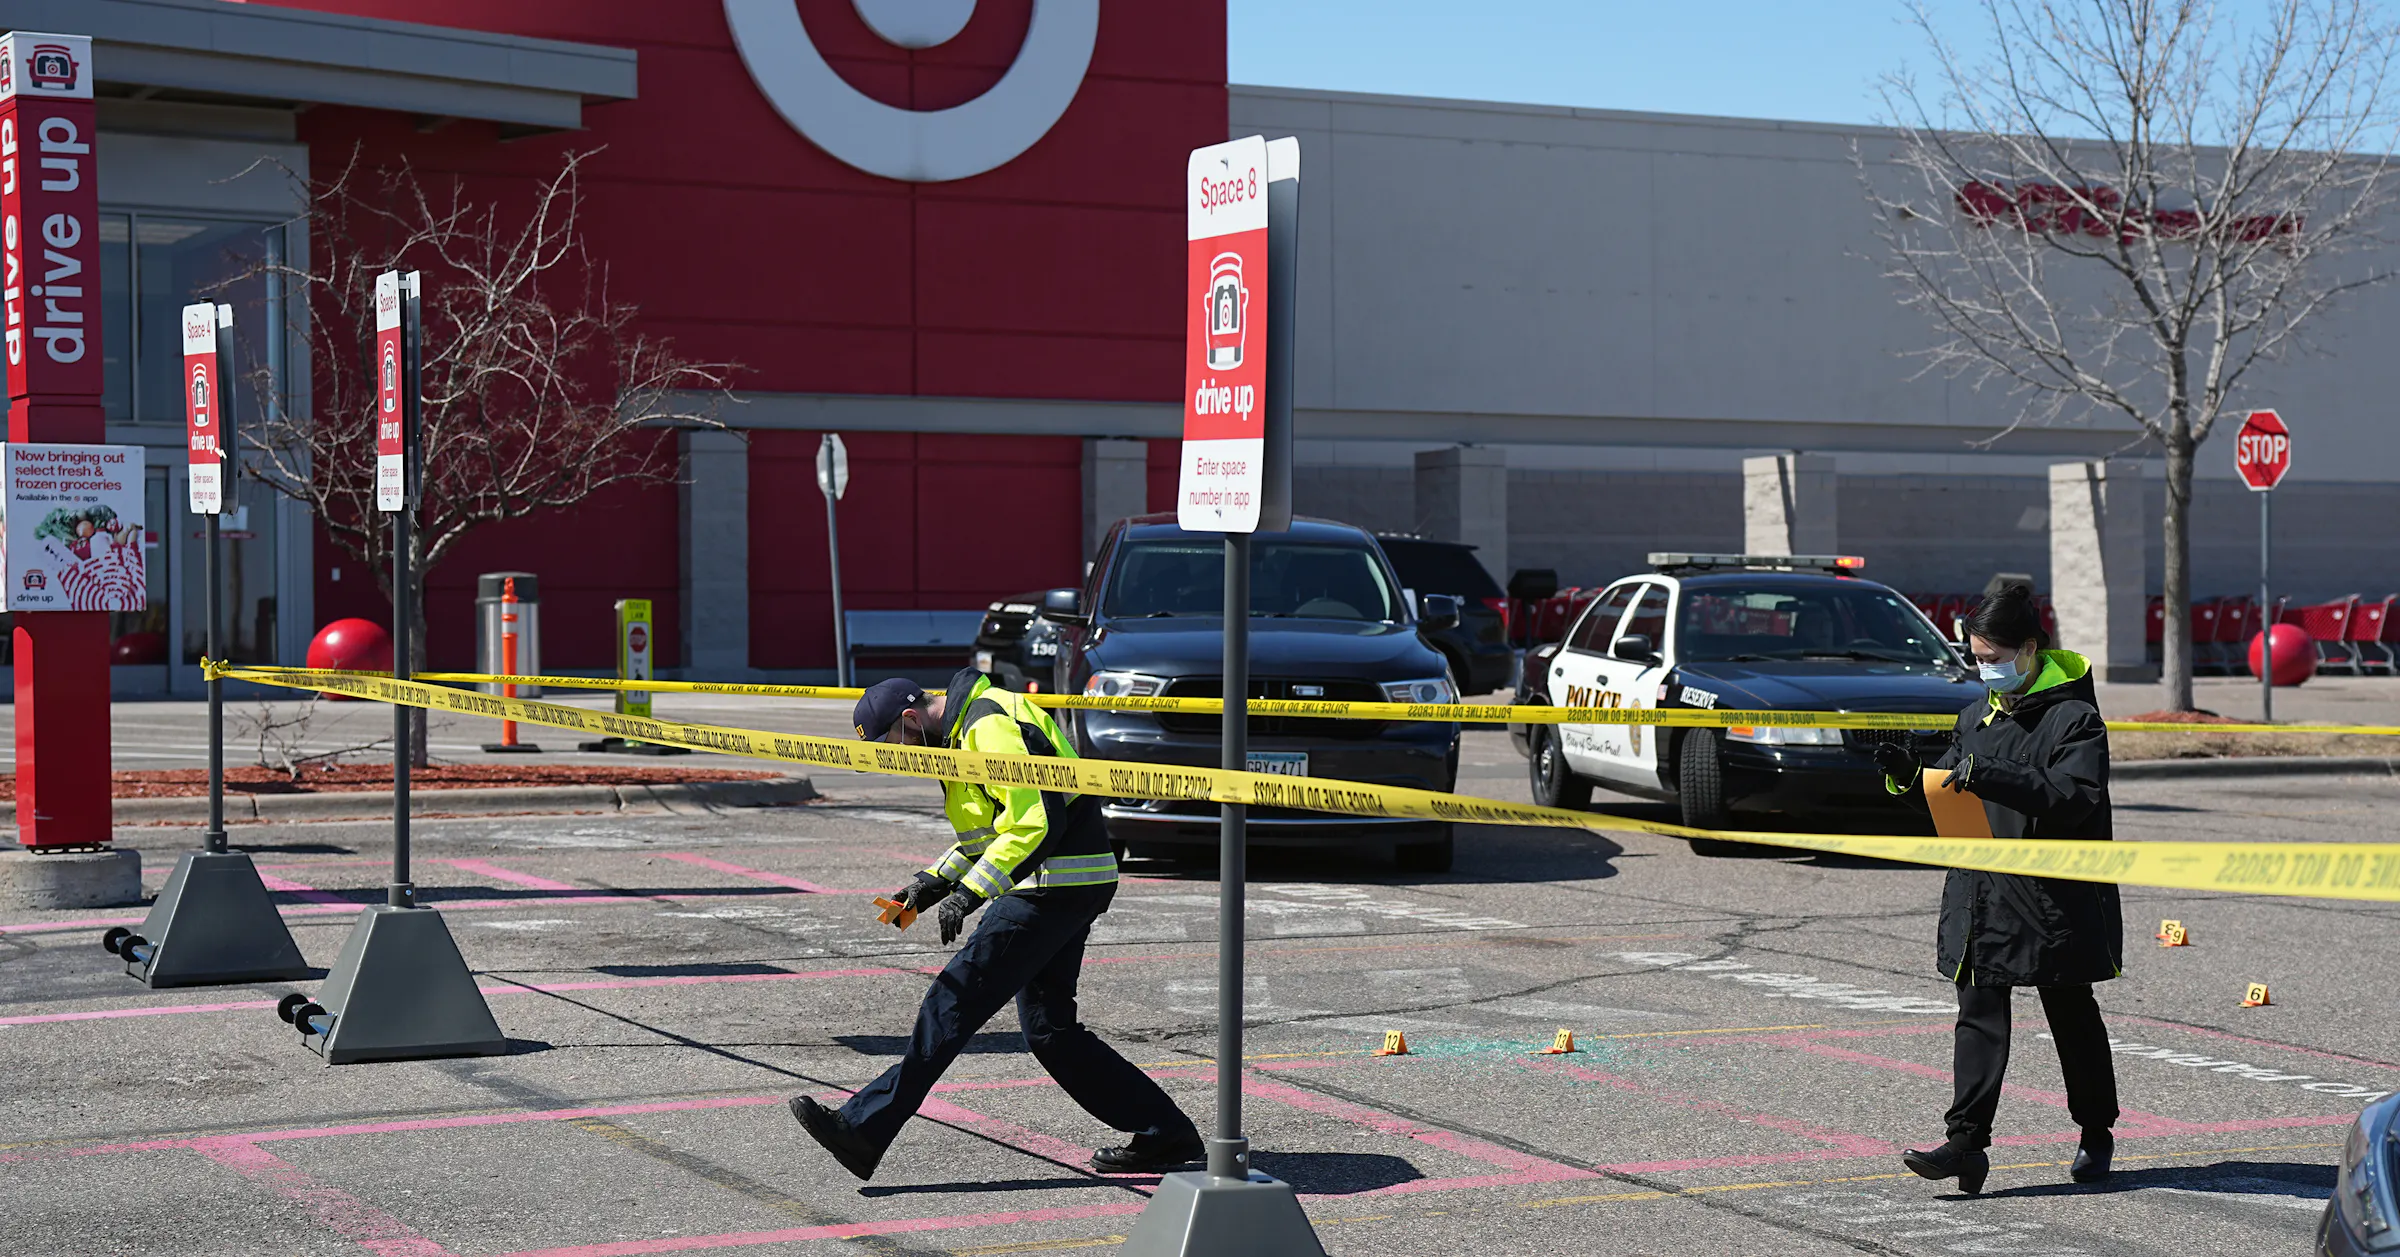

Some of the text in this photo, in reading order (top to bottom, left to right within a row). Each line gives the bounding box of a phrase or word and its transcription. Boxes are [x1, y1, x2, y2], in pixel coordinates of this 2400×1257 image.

[1200, 167, 1257, 217] Space 8
[2, 118, 20, 366] drive up
[30, 117, 90, 364] drive up
[380, 294, 393, 317] Space
[188, 320, 210, 342] Space 4
[1195, 378, 1254, 421] drive up
[206, 435, 216, 454] up
[2239, 434, 2286, 466] STOP
[16, 450, 124, 465] Now bringing out
[1197, 457, 1246, 480] Enter space
[16, 465, 104, 476] select fresh &
[16, 478, 122, 492] frozen groceries
[16, 494, 50, 502] Available
[51, 494, 58, 502] in
[59, 494, 72, 502] the
[1189, 488, 1250, 510] number in app
[17, 594, 40, 602] drive
[1031, 642, 1058, 656] 136
[1565, 685, 1622, 709] POLICE
[1680, 686, 1718, 710] RESERVE
[774, 738, 795, 759] CROSS
[794, 740, 808, 760] NOT
[806, 742, 816, 762] DO
[814, 743, 831, 764] LINE
[830, 745, 852, 766] POLICE
[876, 748, 896, 770] CROSS
[898, 751, 912, 772] NOT
[911, 753, 920, 772] DO
[920, 754, 935, 774] LINE
[936, 756, 960, 778] POLICE
[986, 758, 1010, 782] CROSS
[1010, 761, 1024, 784] NOT
[1280, 760, 1303, 777] 471
[1026, 762, 1036, 784] DO
[1036, 763, 1050, 786] LINE
[1051, 764, 1078, 788] POLICE
[1110, 768, 1135, 794] CROSS
[1136, 771, 1150, 796] NOT
[1154, 772, 1163, 797] DO
[1166, 774, 1183, 798] LINE
[1184, 775, 1213, 800] POLICE
[1253, 781, 1284, 807] CROSS
[1288, 784, 1306, 809] NOT
[1308, 786, 1322, 809] DO
[1323, 788, 1350, 812] LINE
[1348, 790, 1389, 816] POLICE
[2250, 988, 2261, 1000] 6
[1388, 1034, 1398, 1050] 12
[1556, 1034, 1566, 1048] 13
[2109, 1038, 2314, 1081] PARKI
